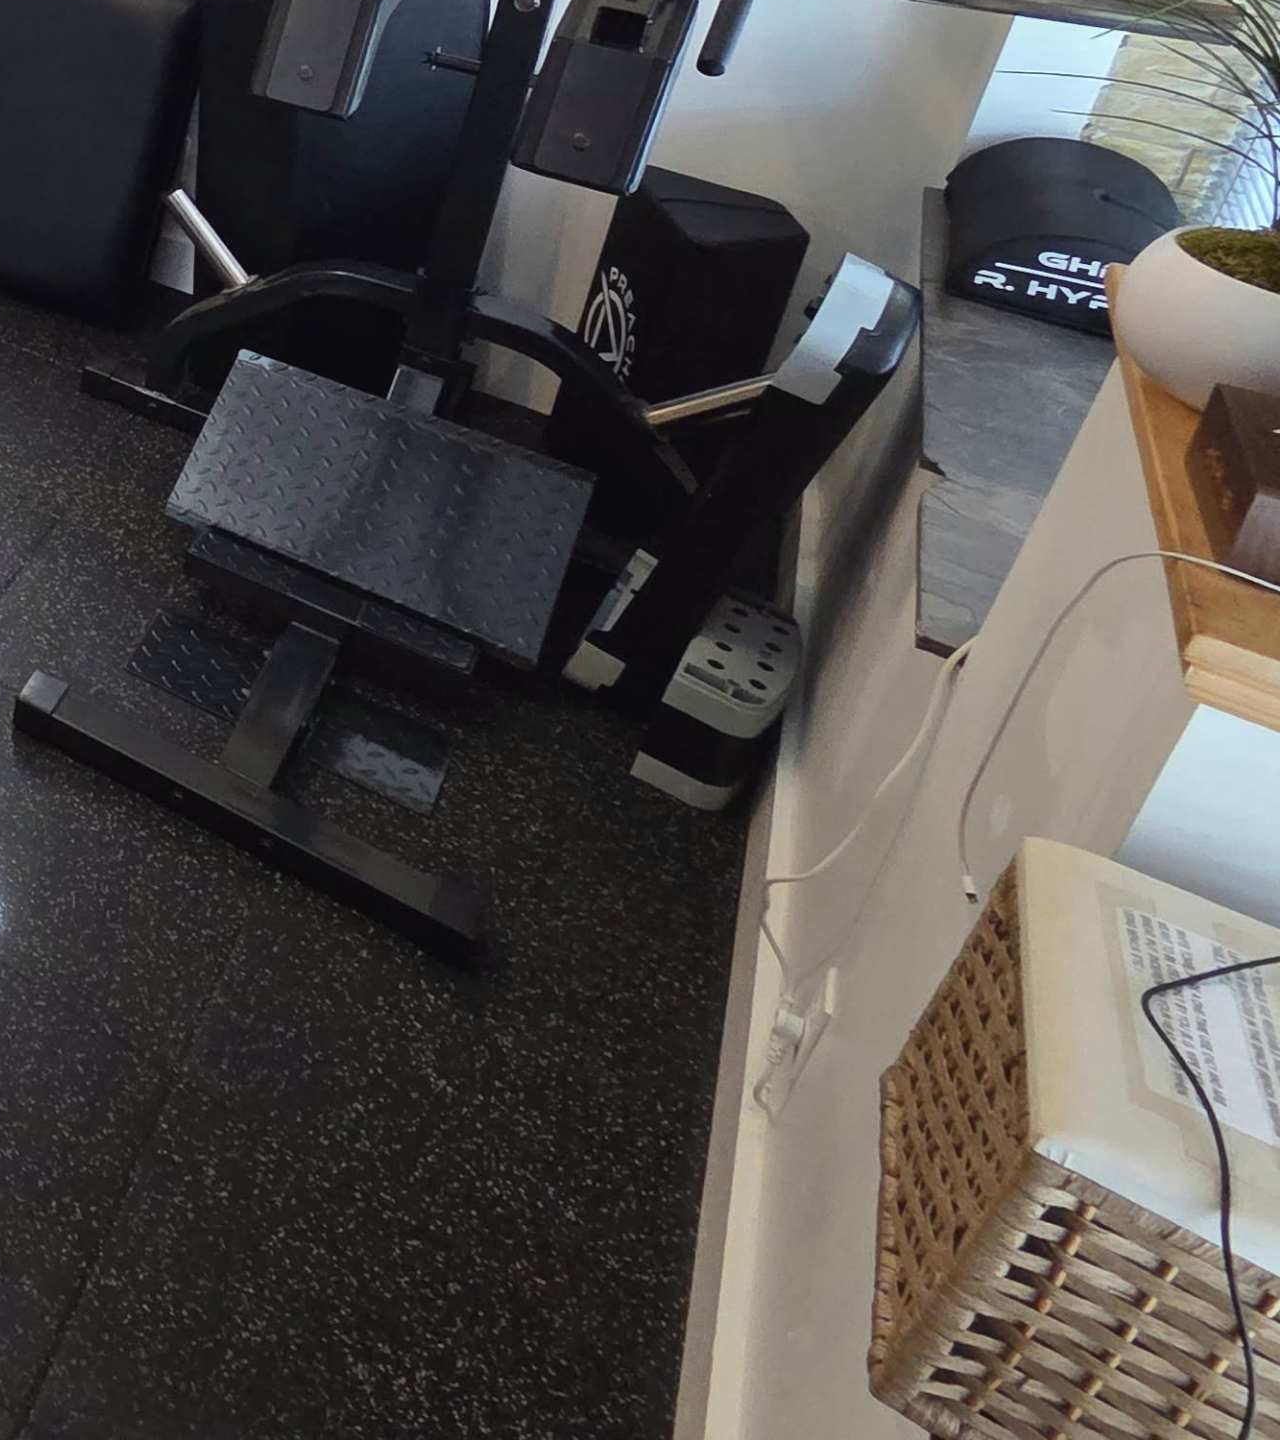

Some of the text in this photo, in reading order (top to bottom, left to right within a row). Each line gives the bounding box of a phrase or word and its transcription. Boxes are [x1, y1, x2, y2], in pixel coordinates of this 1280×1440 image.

[1037, 251, 1108, 279] GH
[973, 269, 1110, 310] R. HYP
